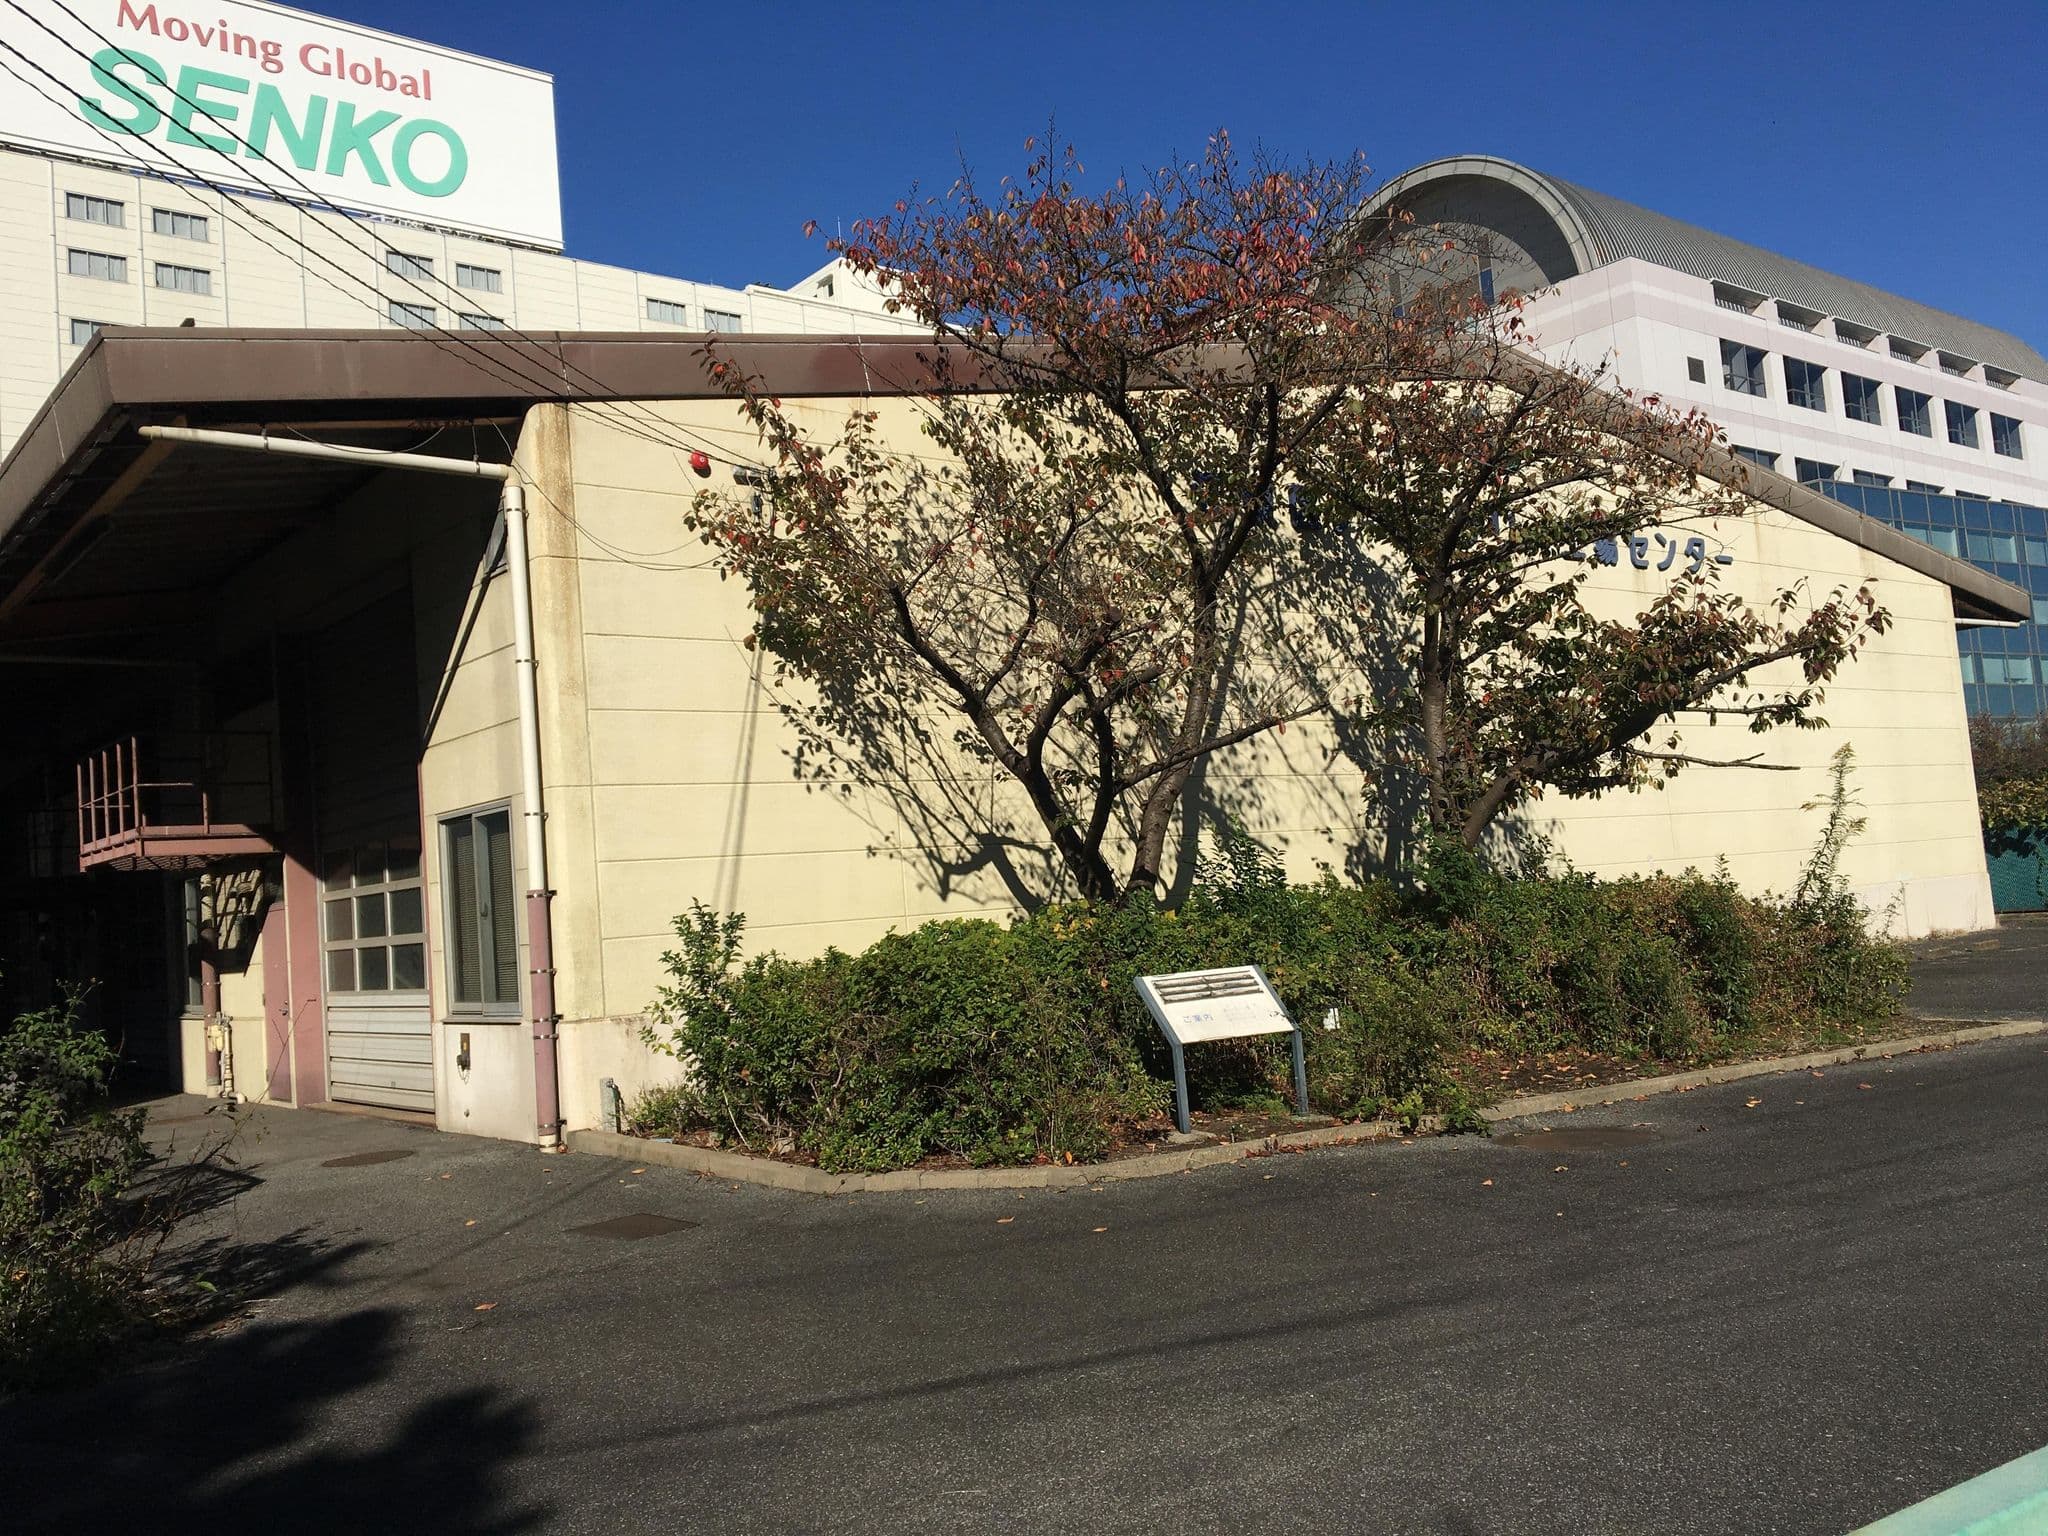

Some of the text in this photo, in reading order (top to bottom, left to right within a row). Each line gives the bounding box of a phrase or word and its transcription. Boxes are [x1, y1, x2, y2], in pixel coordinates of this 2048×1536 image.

[116, 0, 431, 100] Moving Global
[78, 47, 468, 198] SENKO
